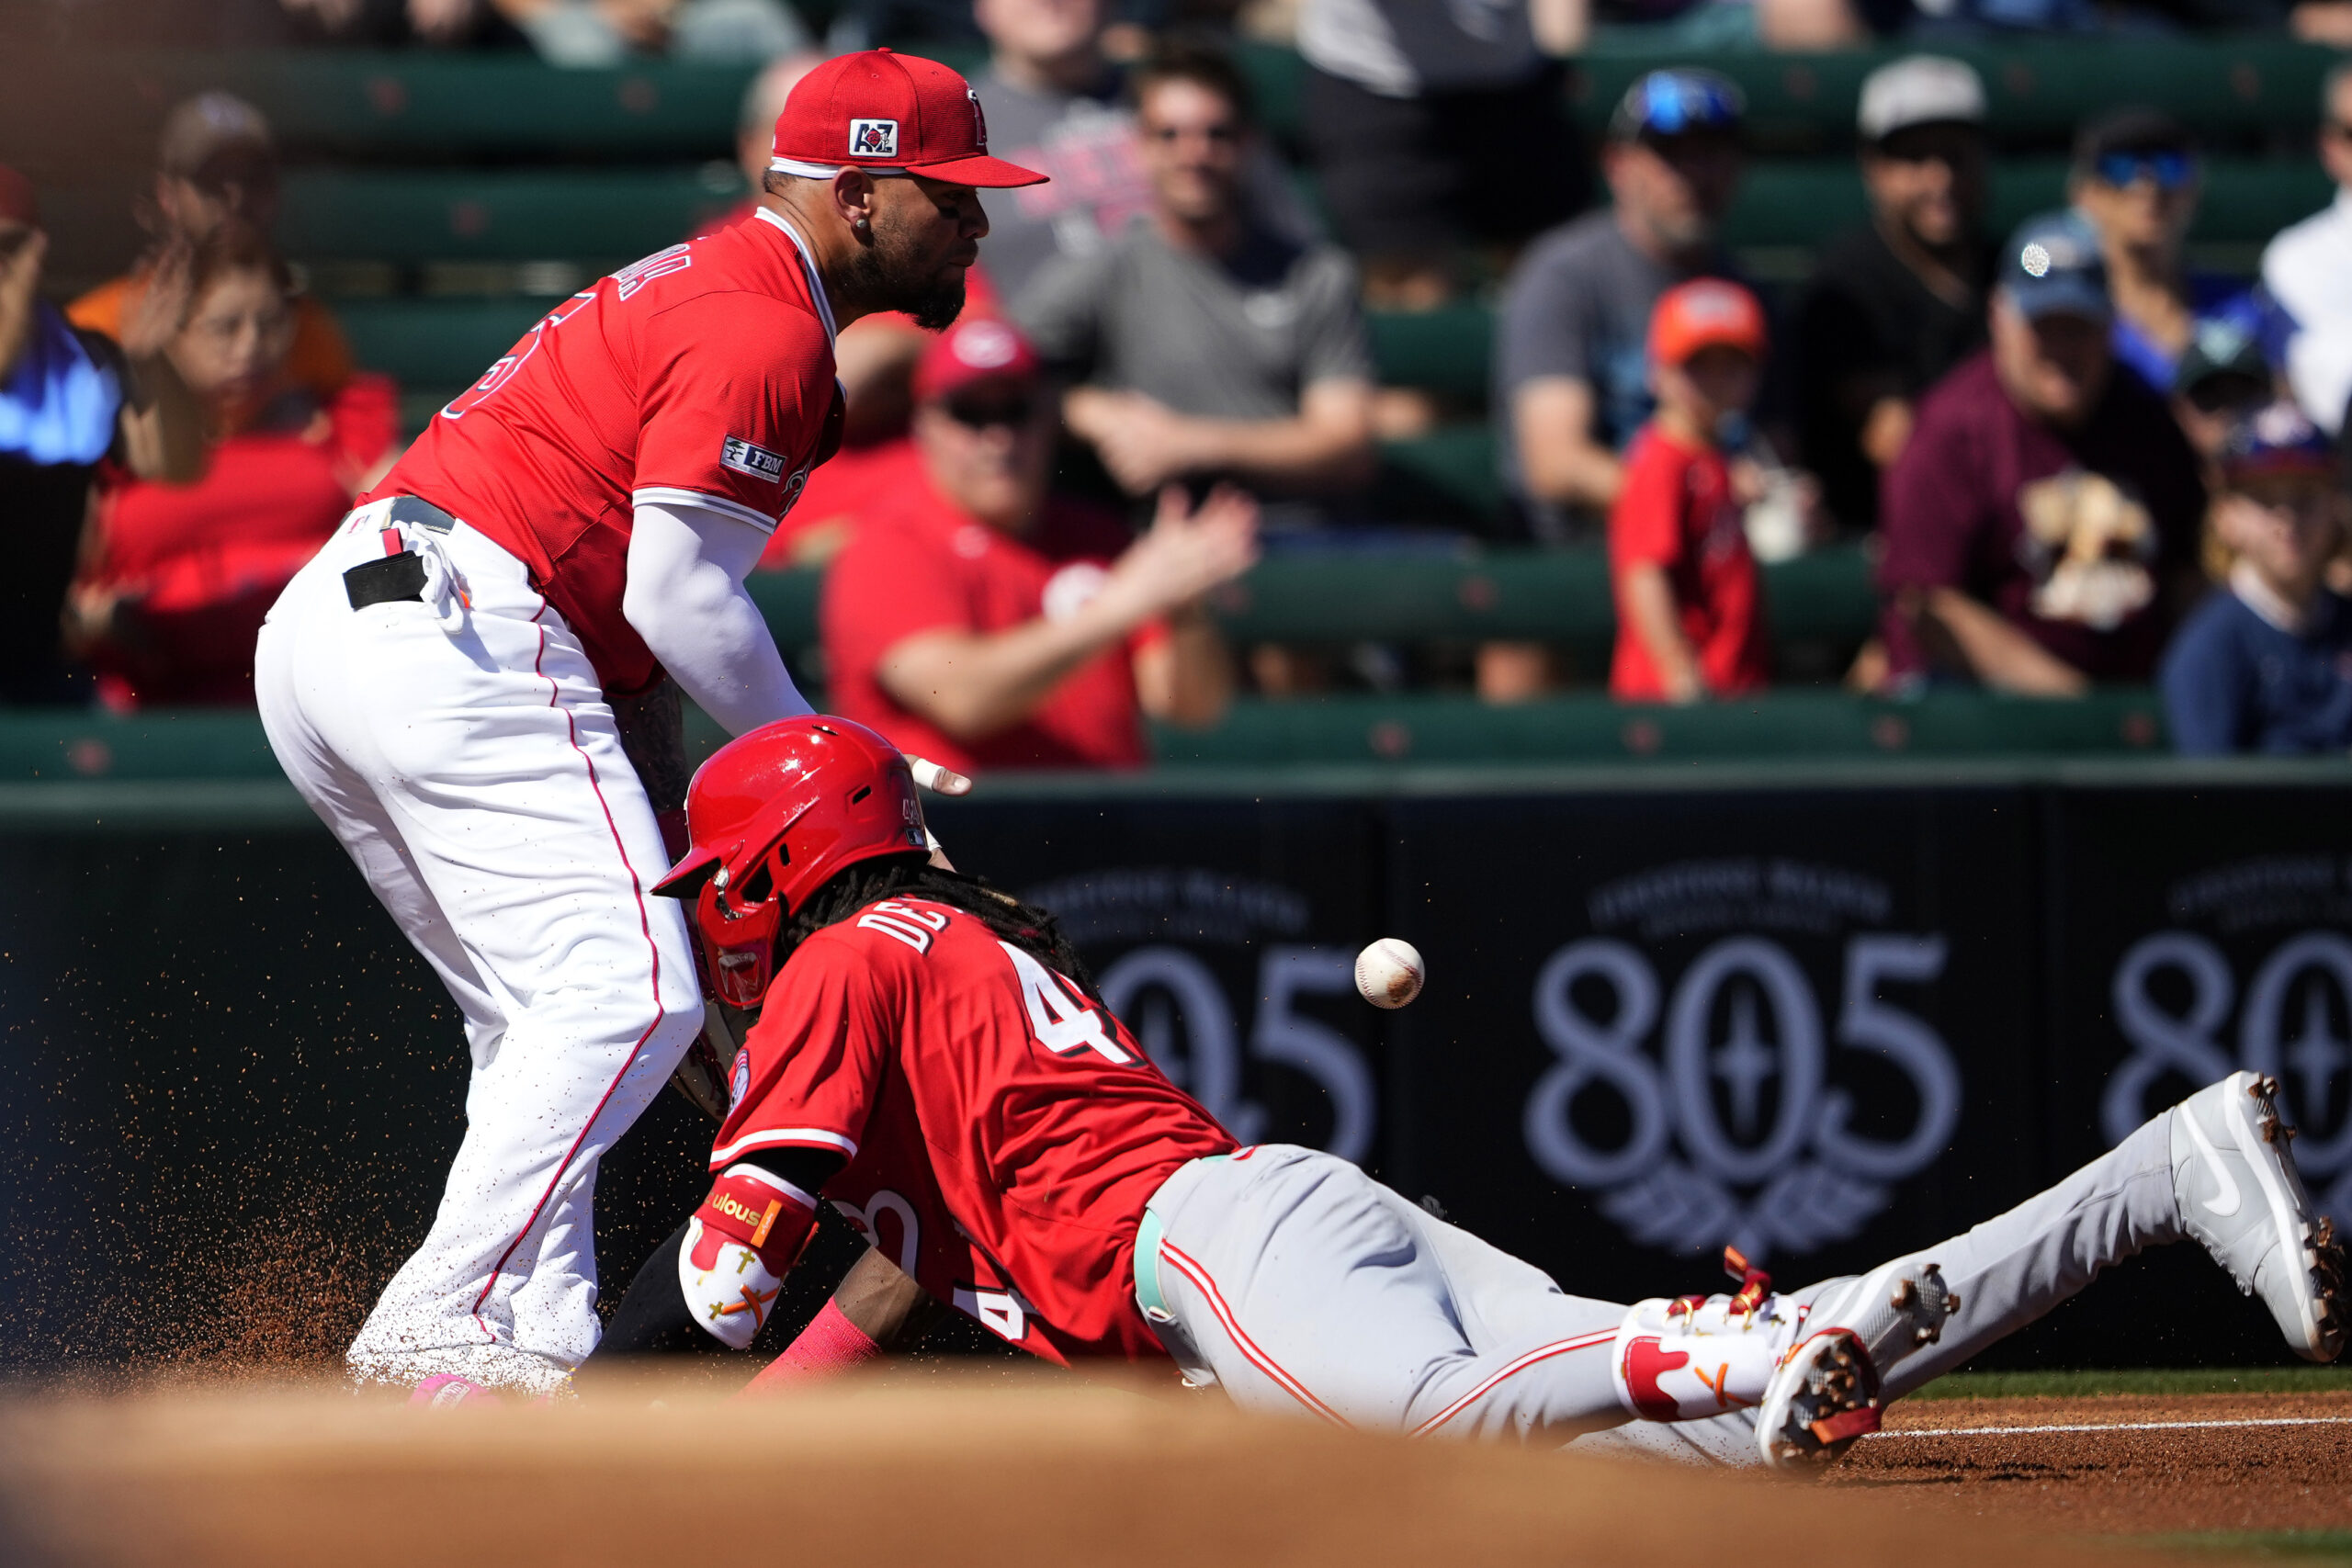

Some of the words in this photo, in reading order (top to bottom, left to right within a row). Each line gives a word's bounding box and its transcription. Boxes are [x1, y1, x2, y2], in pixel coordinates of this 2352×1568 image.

[854, 123, 893, 152] AZ
[752, 450, 783, 473] FBM
[1523, 935, 1964, 1181] 805
